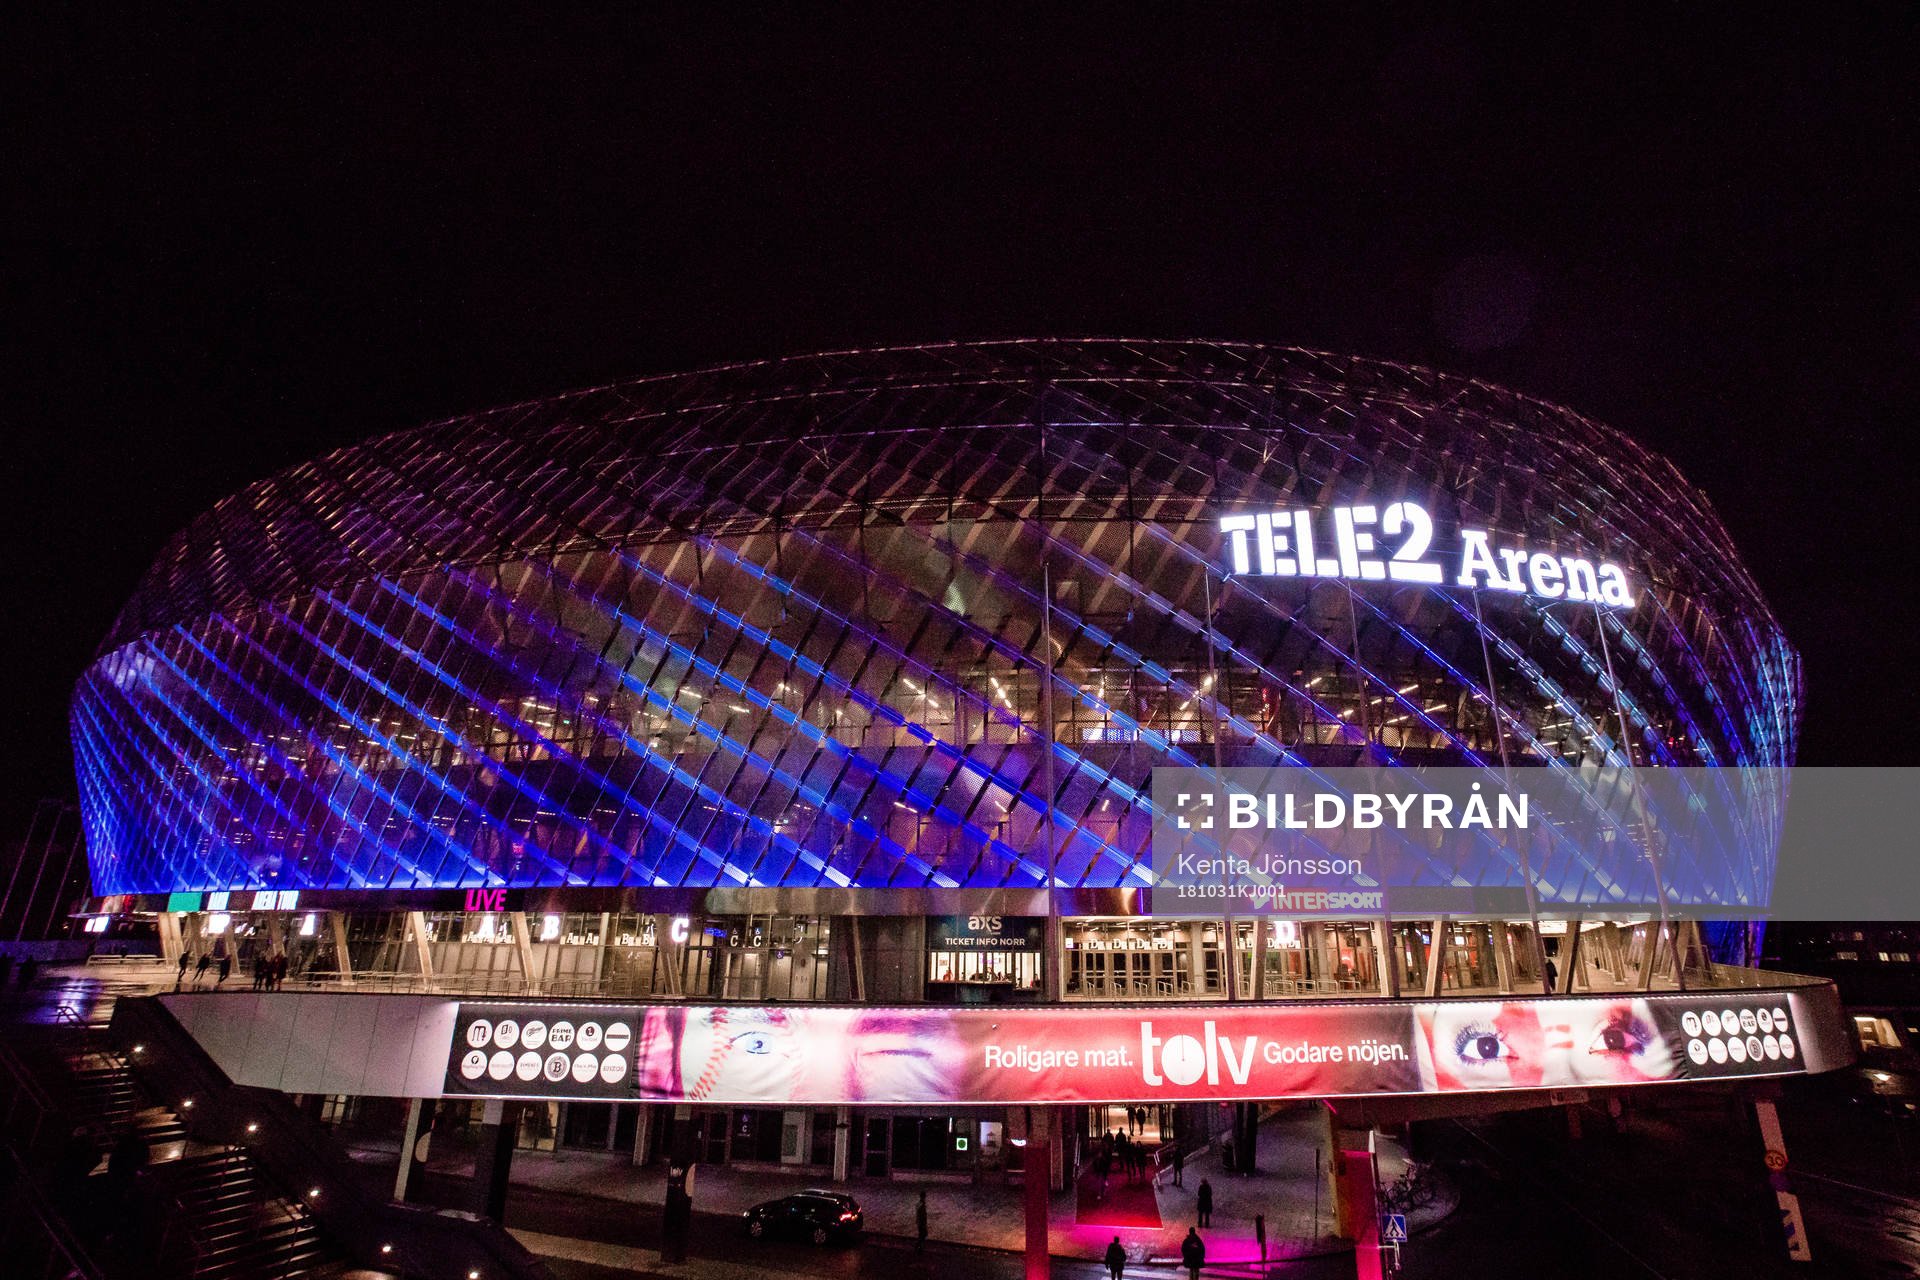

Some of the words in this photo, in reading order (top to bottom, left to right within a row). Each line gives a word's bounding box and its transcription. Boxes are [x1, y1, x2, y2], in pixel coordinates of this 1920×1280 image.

[1220, 501, 1443, 583] TELE2
[1456, 529, 1636, 608] Arena
[465, 889, 507, 911] LIVE
[1272, 892, 1383, 911] INTERSPORT
[540, 916, 560, 942] B
[672, 918, 690, 943] C
[968, 916, 1002, 933] axs
[1274, 920, 1295, 944] D
[566, 933, 575, 944] A
[585, 933, 594, 944] A
[621, 934, 630, 945] B
[642, 934, 651, 945] B
[730, 935, 739, 947] C
[753, 935, 762, 947] C
[945, 938, 975, 946] TICKET
[976, 938, 998, 946] INFO
[1000, 938, 1026, 946] NORR
[1090, 938, 1098, 949] D
[1113, 938, 1121, 949] D
[1136, 938, 1145, 949] D
[1266, 938, 1275, 948] D
[551, 1034, 572, 1042] BAR
[1141, 1021, 1258, 1086] tolv
[1263, 1040, 1343, 1065] Godare
[1346, 1038, 1410, 1066] nöjen.
[985, 1045, 1079, 1072] Roligare
[1084, 1047, 1134, 1068] mat.
[552, 1061, 562, 1073] B
[1767, 1155, 1784, 1167] 30
